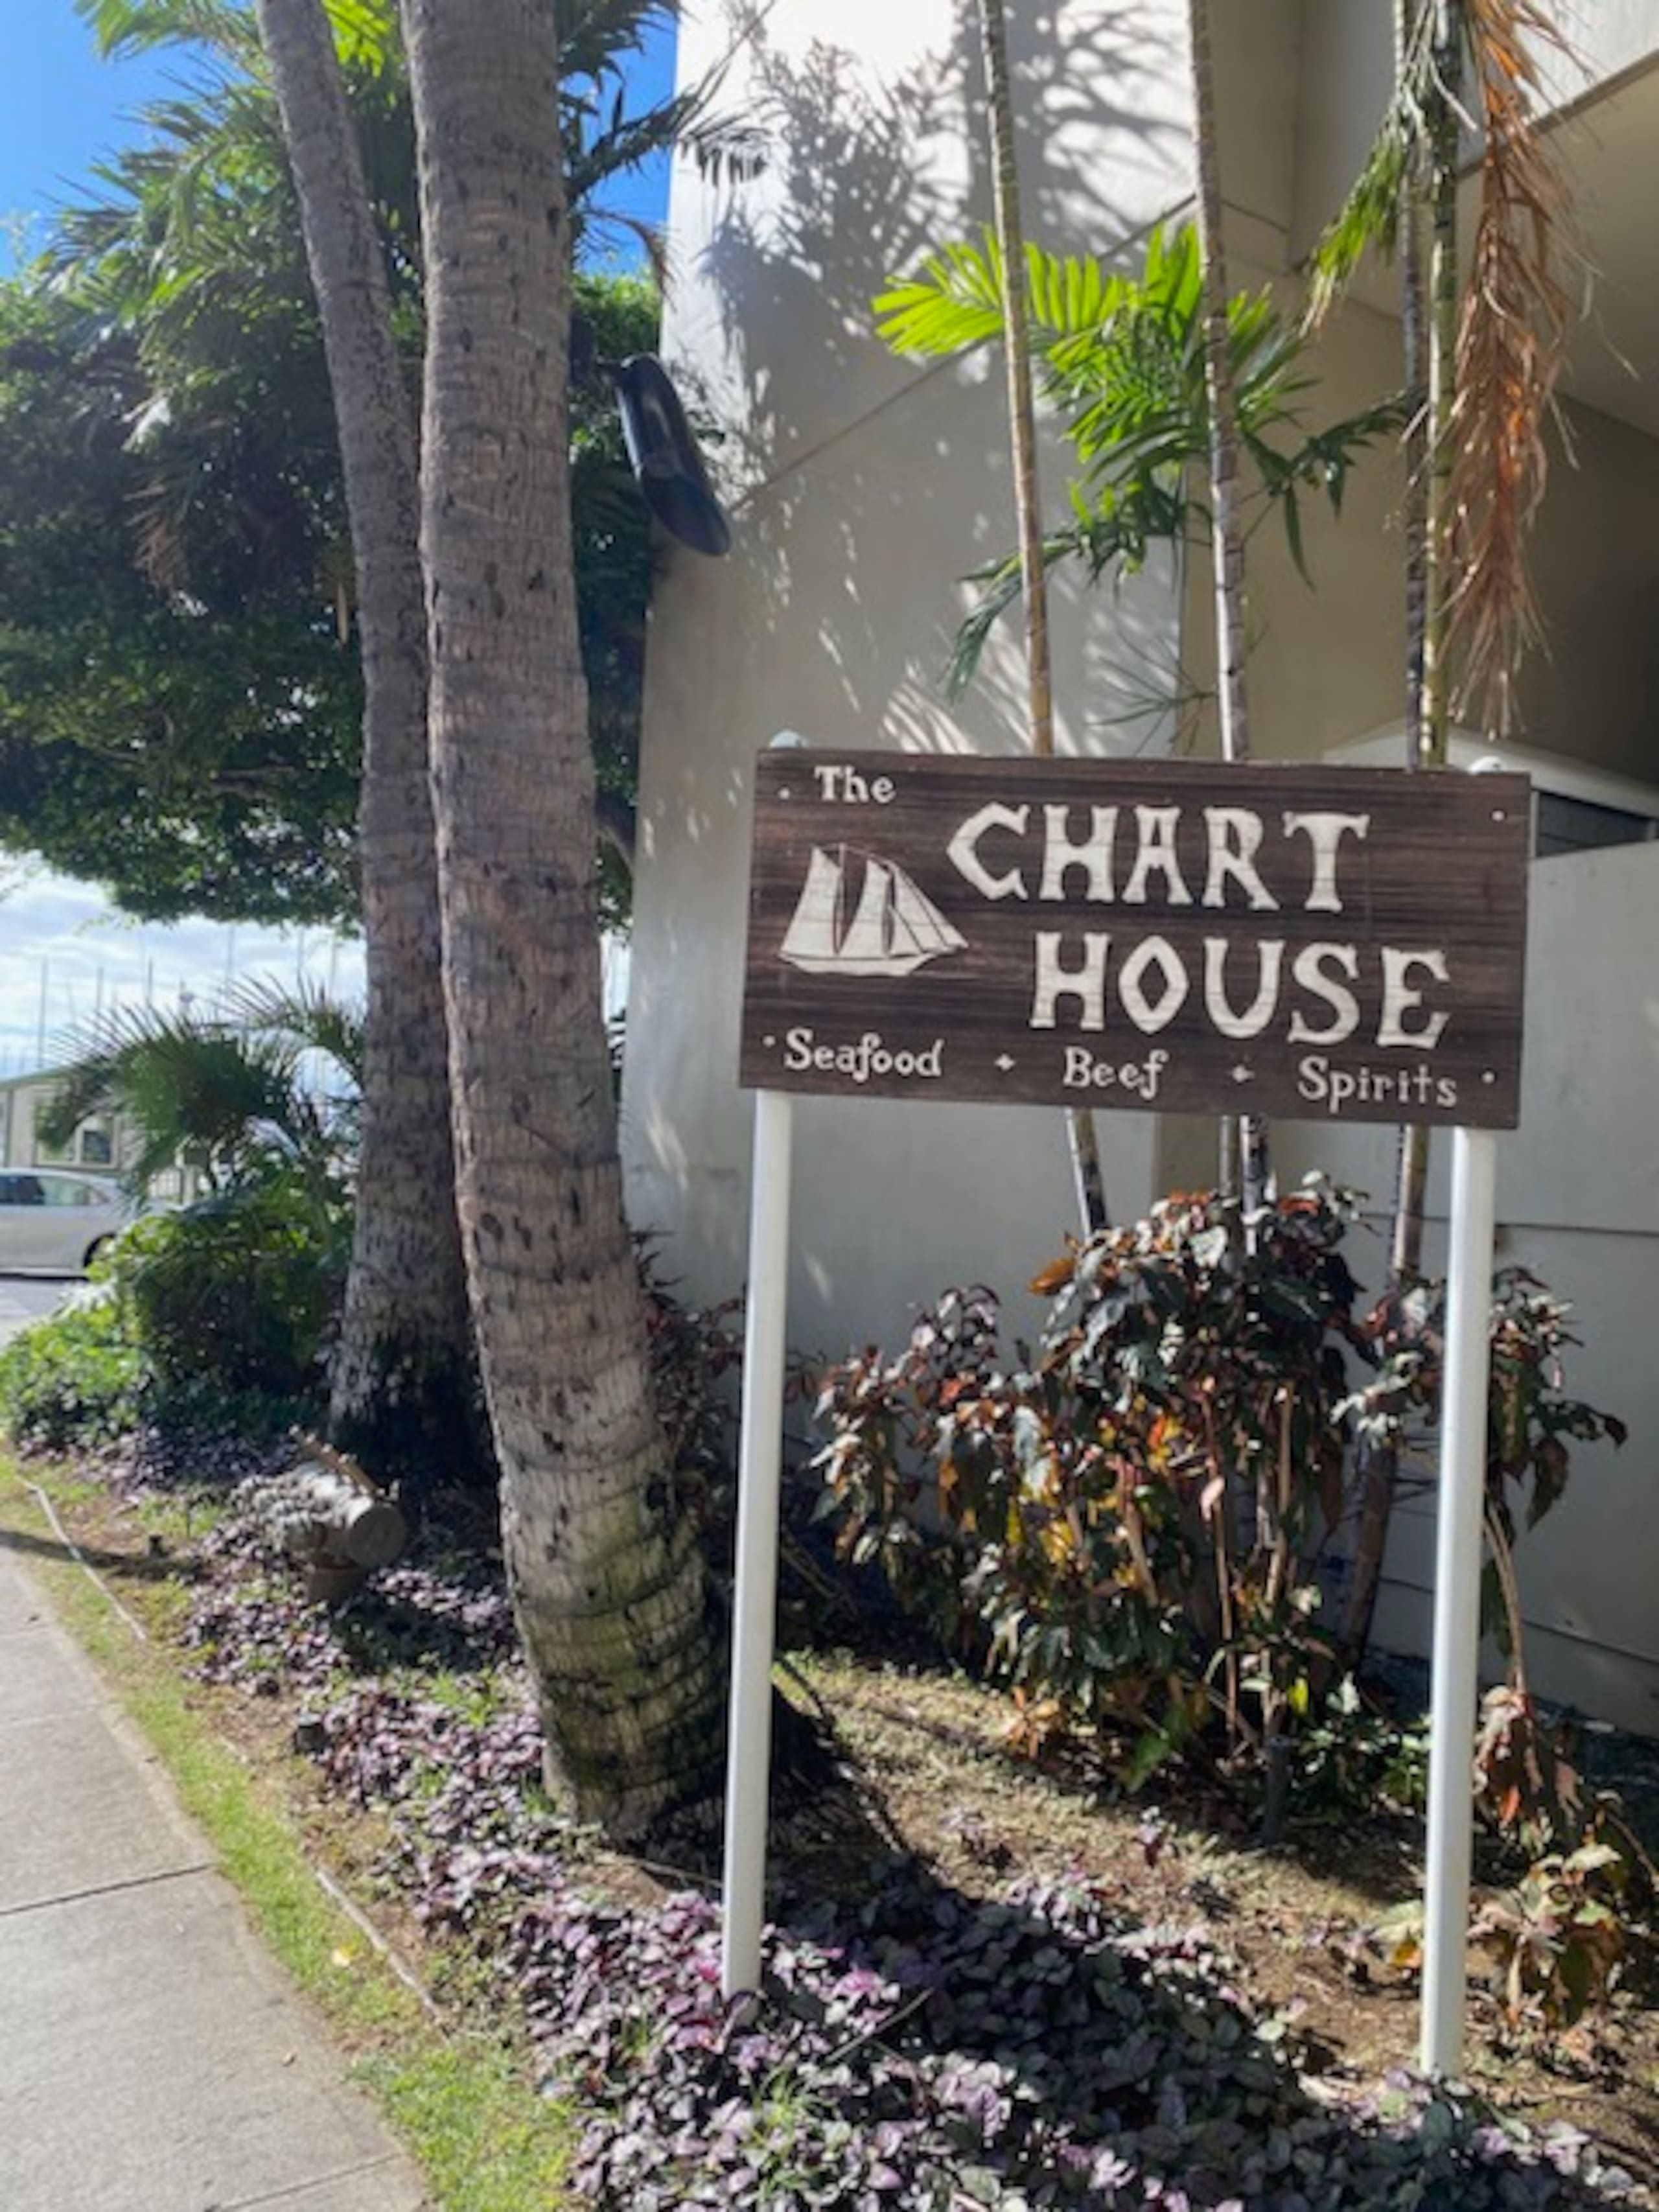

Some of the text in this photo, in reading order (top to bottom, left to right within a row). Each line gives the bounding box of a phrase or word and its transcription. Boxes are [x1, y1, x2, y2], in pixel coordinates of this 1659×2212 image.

[814, 765, 896, 803] The
[946, 802, 1370, 912] CHART
[1029, 931, 1451, 1049] HOUSE
[783, 1028, 1458, 1112] Seafood Beef Spirits
